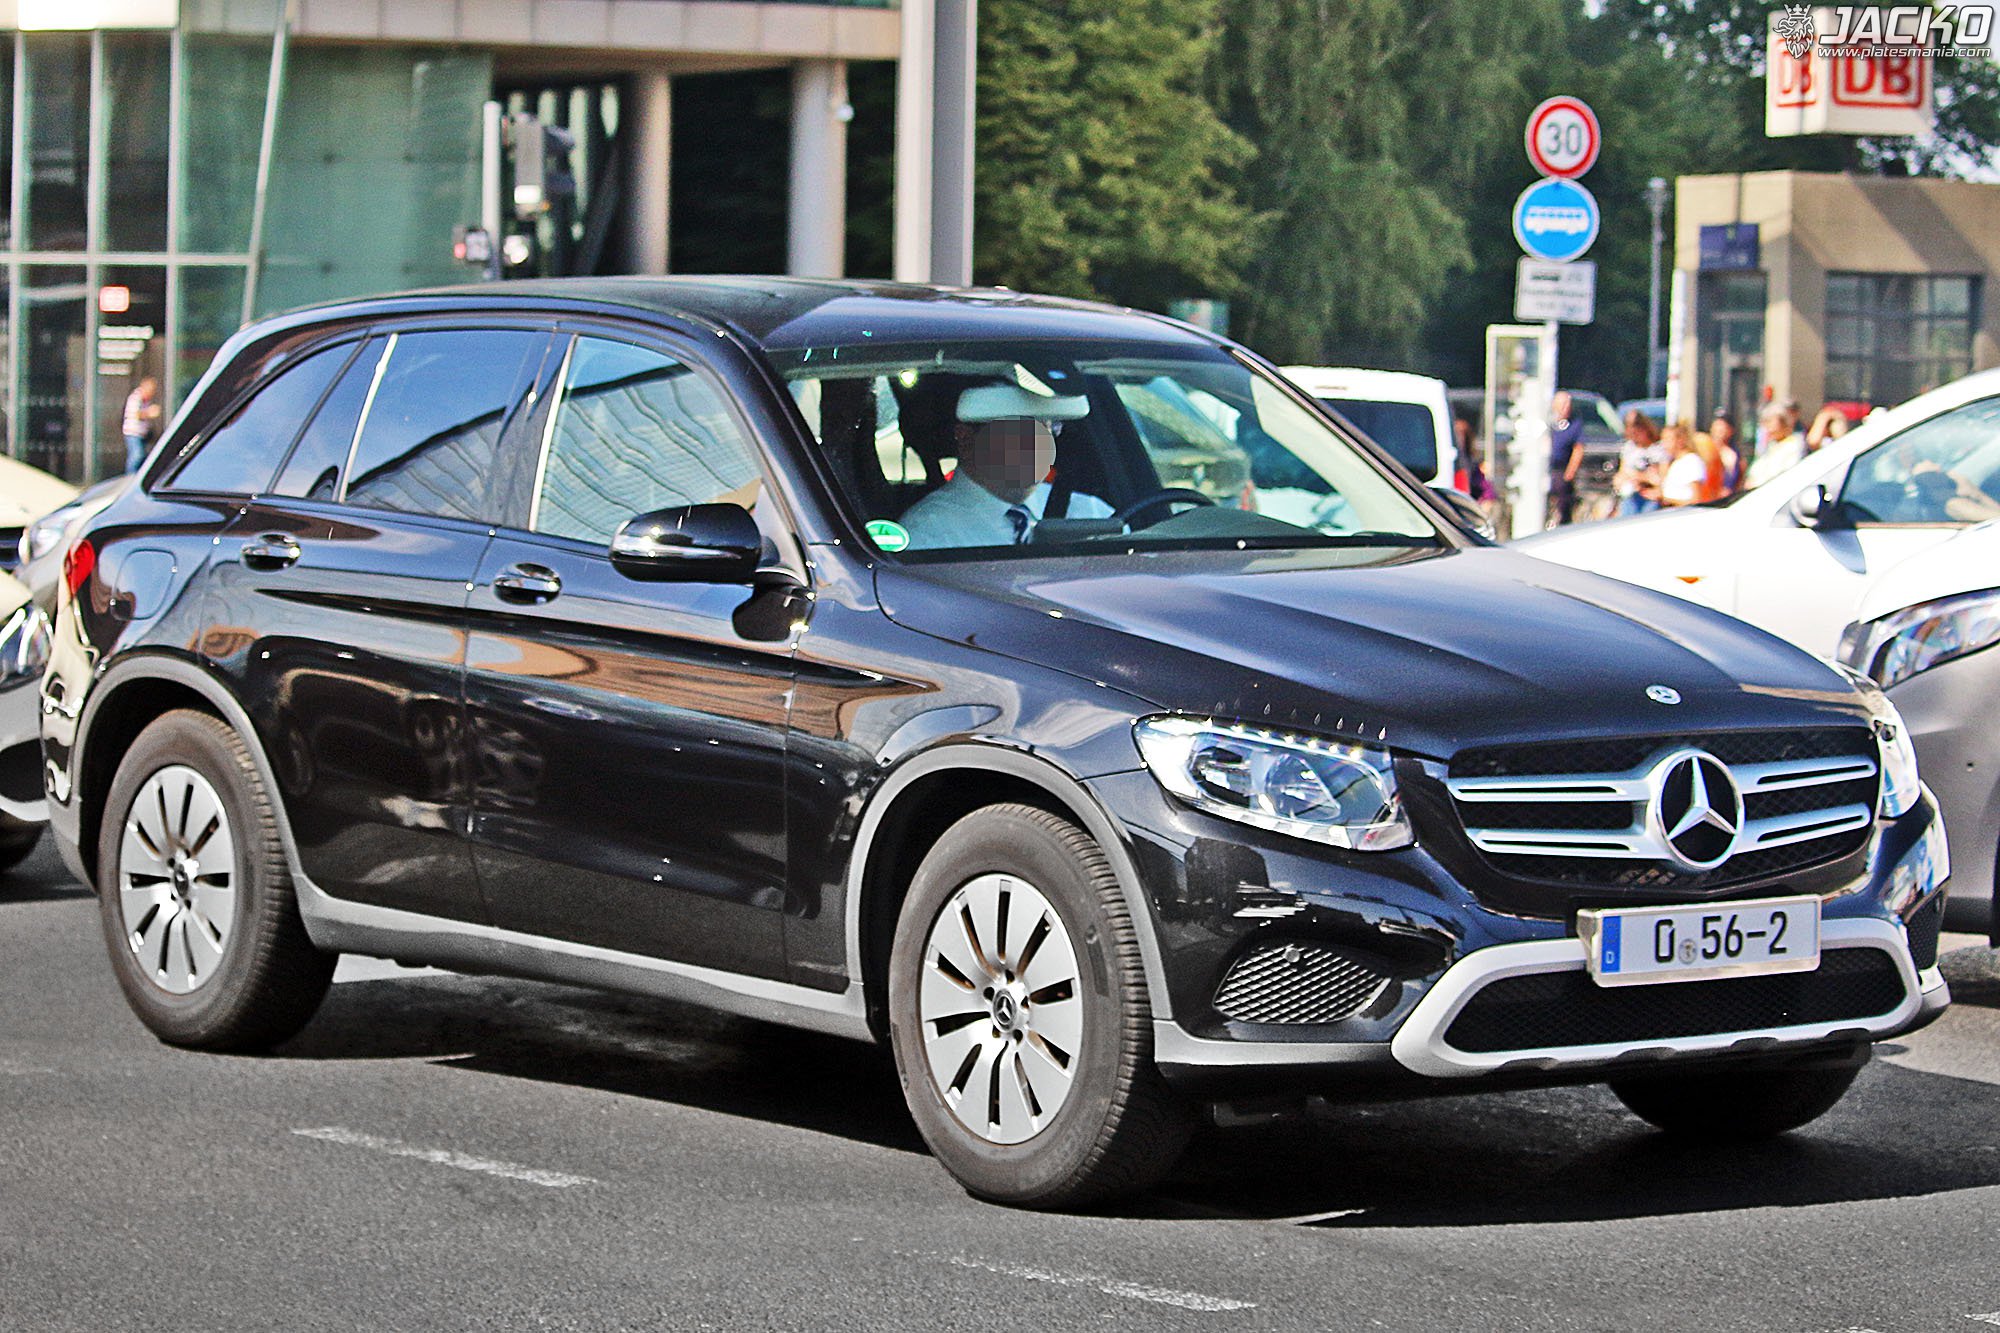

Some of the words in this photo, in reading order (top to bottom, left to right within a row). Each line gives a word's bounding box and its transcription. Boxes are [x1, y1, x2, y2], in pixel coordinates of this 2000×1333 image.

[1844, 46, 1911, 95] DB
[1545, 121, 1583, 156] 30
[1701, 911, 1788, 960] 56-2
[1605, 951, 1614, 964] D
